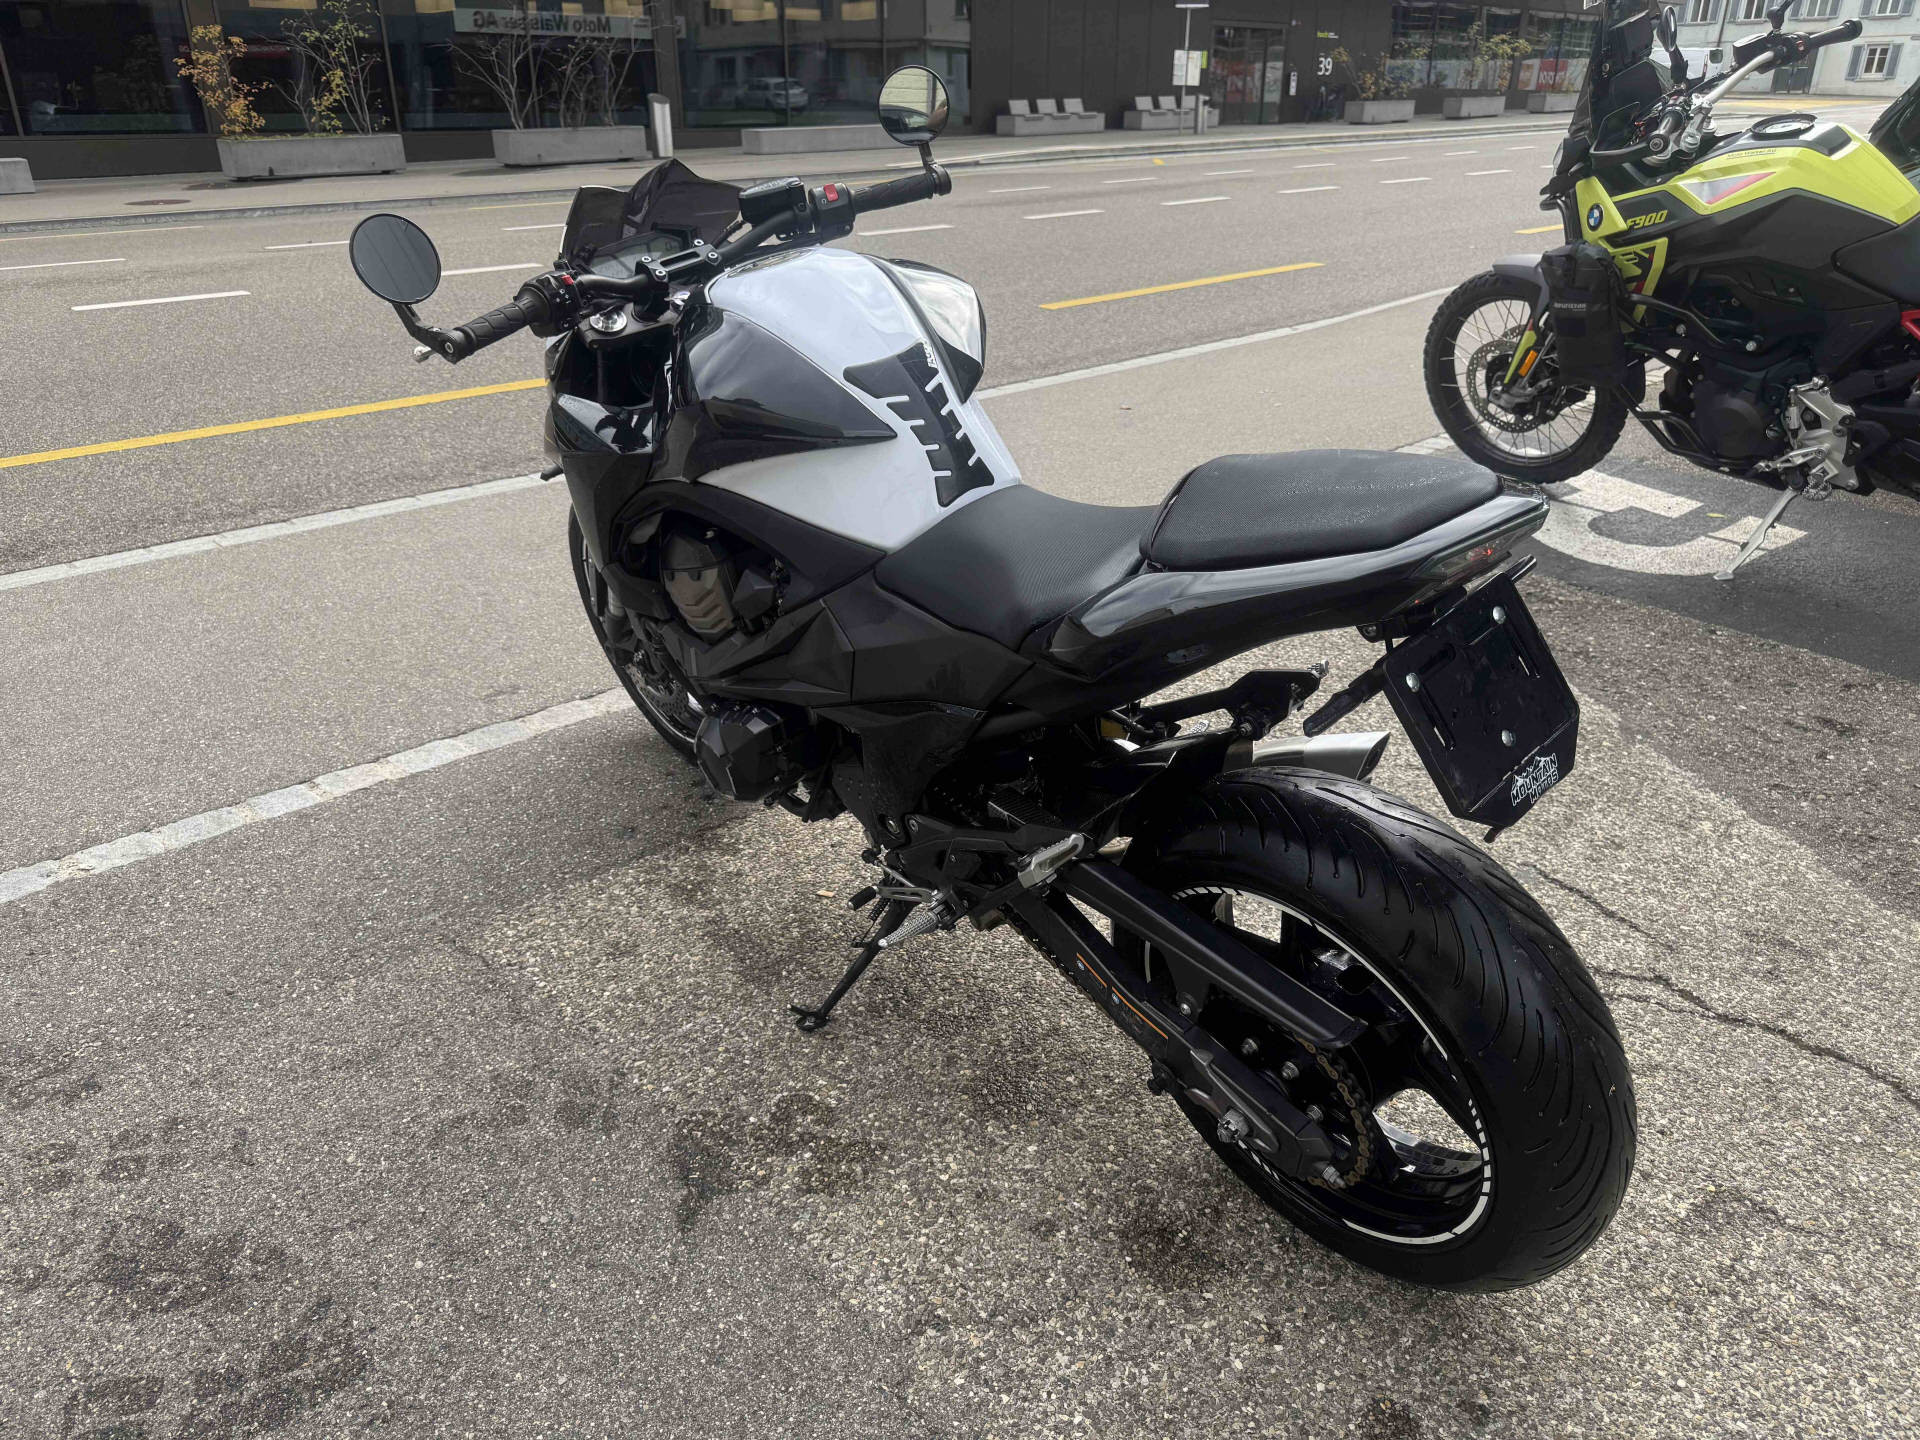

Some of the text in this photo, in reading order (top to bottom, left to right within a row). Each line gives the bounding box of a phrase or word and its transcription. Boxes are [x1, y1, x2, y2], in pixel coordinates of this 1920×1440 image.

[1317, 57, 1333, 75] 39
[1627, 211, 1668, 228] F900
[1511, 754, 1558, 806] MOUNTAIN
[1530, 769, 1559, 803] MOTOS
